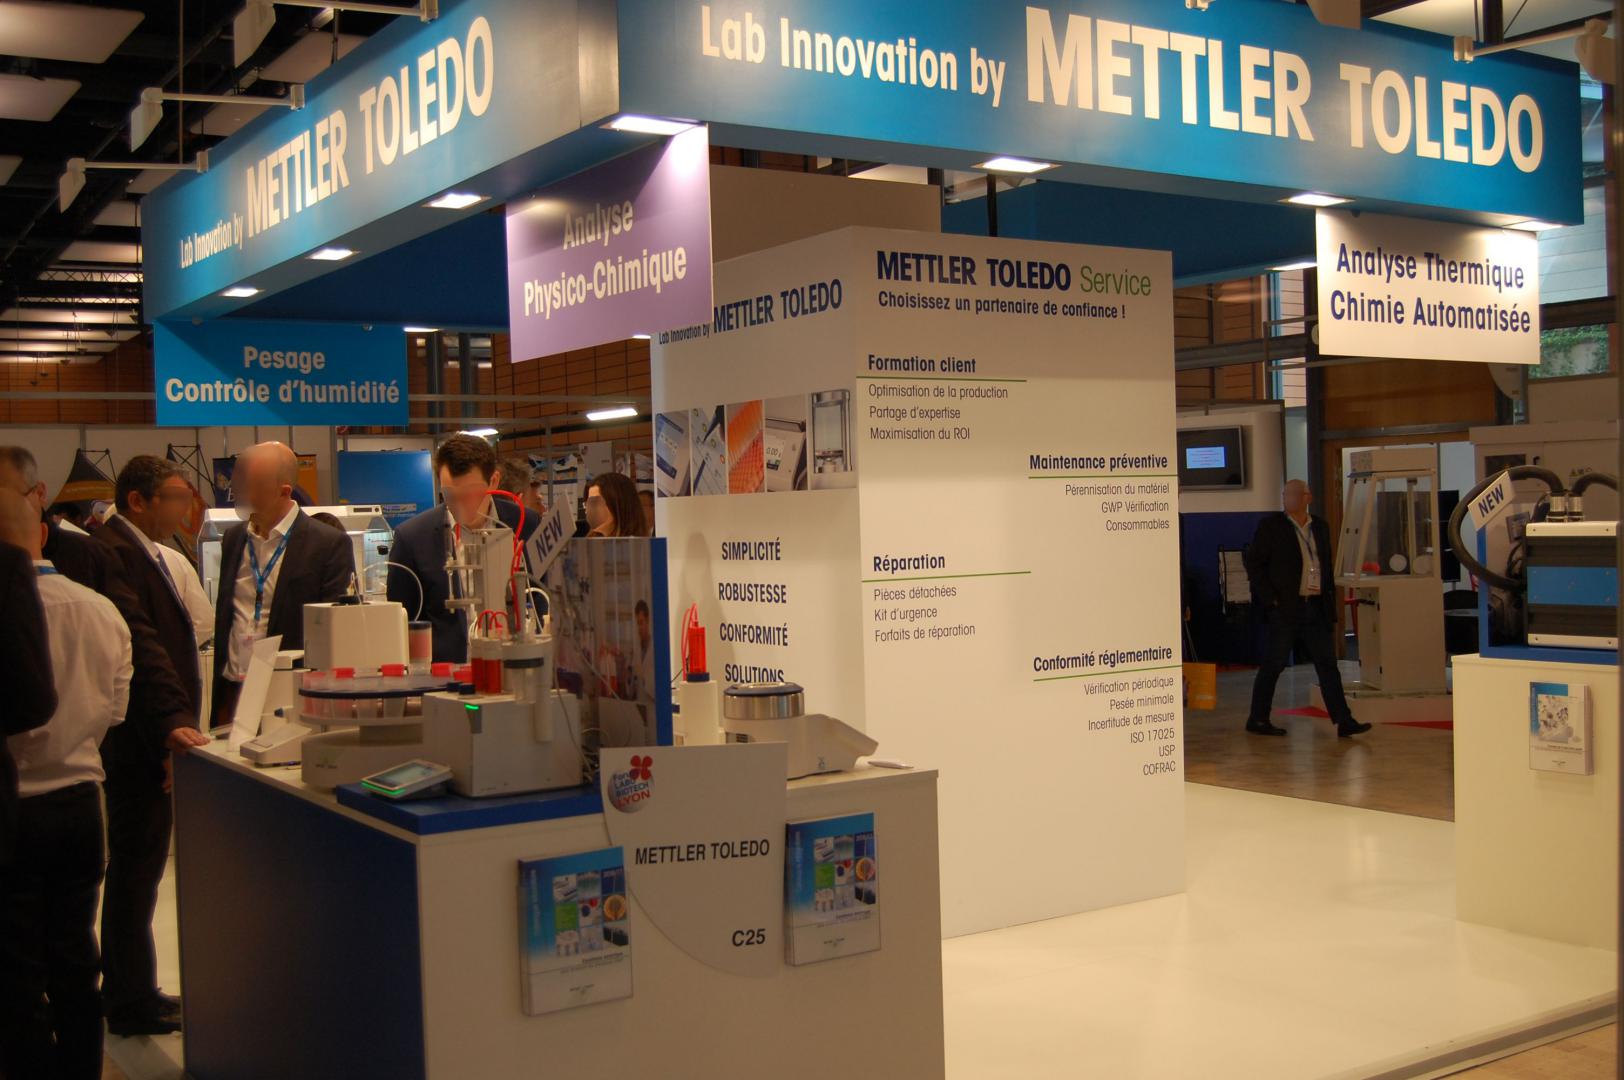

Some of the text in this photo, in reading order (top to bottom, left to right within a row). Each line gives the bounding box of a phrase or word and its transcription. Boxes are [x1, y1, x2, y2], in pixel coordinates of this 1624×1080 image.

[701, 6, 1543, 173] Lab Innovation by METTLER TOLEDO
[180, 16, 494, 269] Lab Innovation by METTLER TOLEDO
[563, 200, 634, 249] Analyse
[877, 250, 1151, 296] METTLER TOLEDO Service
[1336, 243, 1524, 293] Analyse Thermique
[524, 247, 687, 320] Physico-Chimique
[659, 278, 842, 345] Lab Innovation by METTLER TOLEDO
[878, 291, 1126, 318] Choisissez un partenaire de confiance !
[1330, 289, 1531, 333] Chimie Automatisée
[243, 345, 325, 373] Pesage
[868, 354, 976, 373] Formation client
[165, 378, 400, 404] Contrôle d'humidité
[868, 383, 1008, 401] Optimisation de la production
[869, 405, 961, 421] Partage d'expertise
[870, 427, 970, 440] Maximisation du ROI
[1029, 454, 1168, 472] Maintenance préventive
[1065, 482, 1169, 496] Pérennisation du matériel
[1101, 500, 1169, 514] GWP Vérification
[1478, 484, 1505, 518] NEW
[1106, 518, 1169, 532] Consommables
[535, 510, 563, 563] NEW
[721, 536, 781, 561] SIMPLICITÉ
[873, 554, 946, 575] Réparation
[718, 582, 787, 604] ROBUSTESSE
[874, 585, 957, 601] Pièces détachées
[874, 606, 938, 623] Kit d'urgence
[719, 622, 788, 647] CONFORMITÉ
[875, 624, 976, 643] Forfaits de réparation
[1033, 645, 1172, 672] Conformité réglementaire
[725, 663, 785, 684] SOLUTIONS
[1084, 676, 1174, 695] Vérification périodique
[1110, 693, 1174, 710] Pesée minimale
[1089, 711, 1175, 731] Incertitude de mesure
[1130, 728, 1175, 744] ISO 17025
[1159, 745, 1176, 757] USP
[1143, 761, 1176, 776] COFRAC
[635, 838, 770, 865] METTLER TOLEDO
[731, 927, 766, 947] C25
